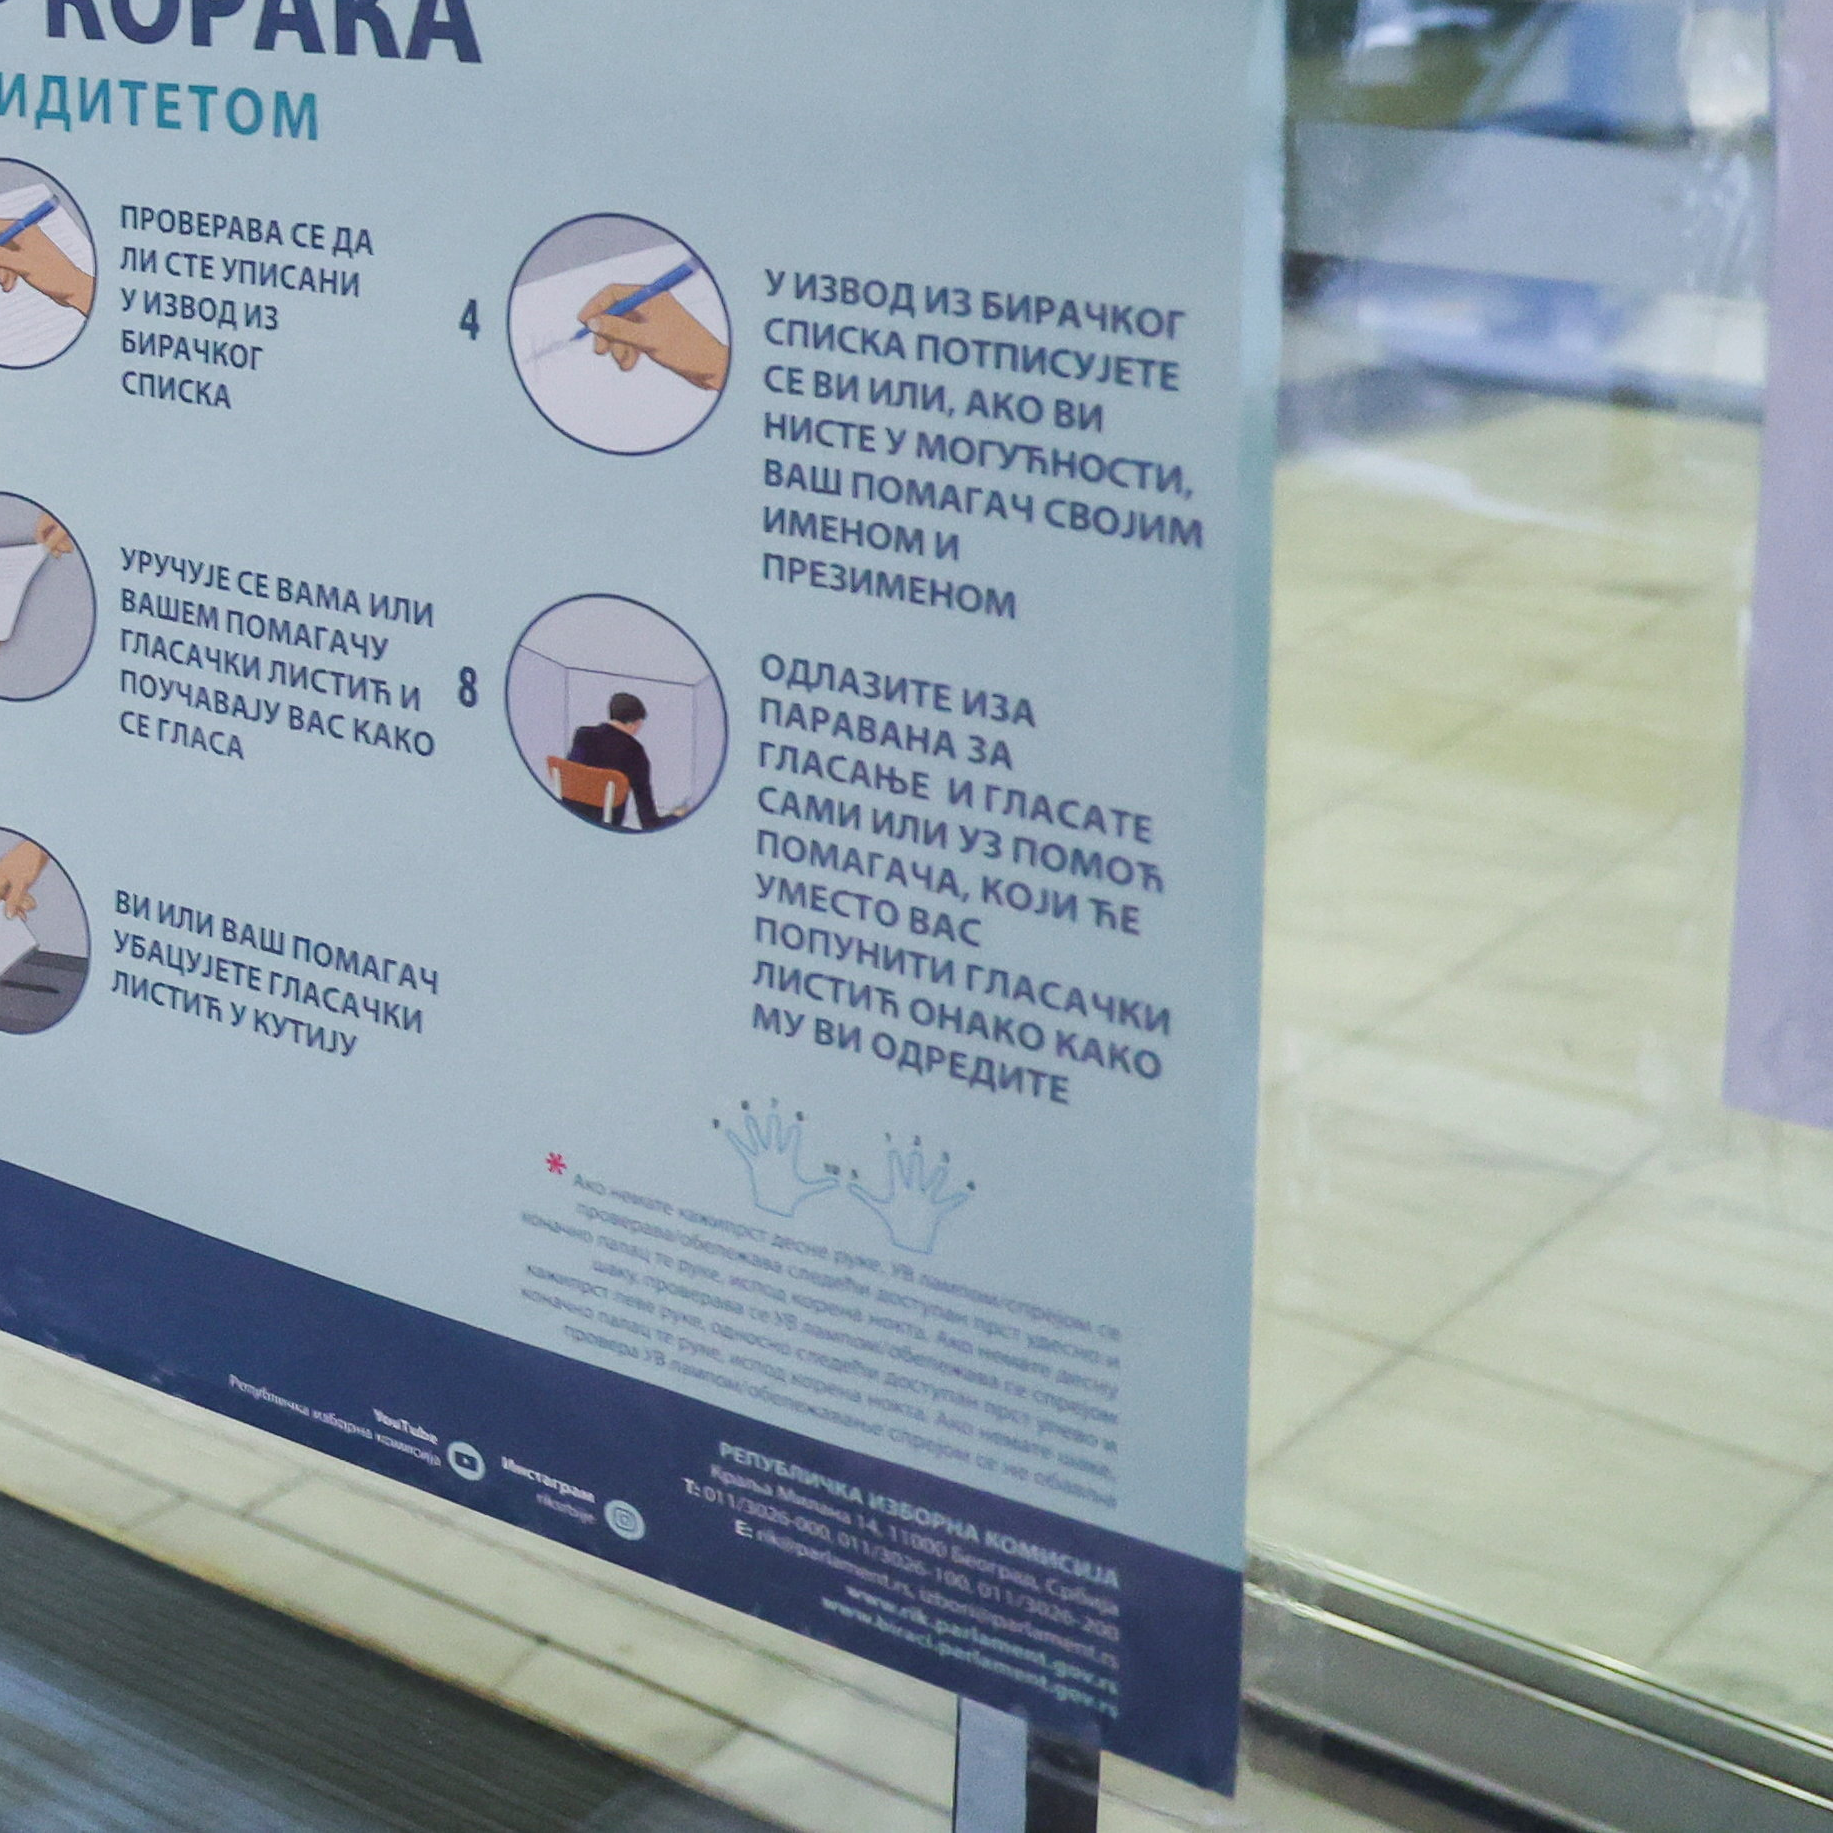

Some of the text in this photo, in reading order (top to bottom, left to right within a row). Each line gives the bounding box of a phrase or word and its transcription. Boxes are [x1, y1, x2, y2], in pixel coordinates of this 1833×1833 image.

[121, 205, 374, 258] ПРОВЕРАВА СЕ ДА
[121, 247, 360, 298] ЛИ СТЕ УПИСАНИ
[121, 288, 278, 331] У ИЗВОД ИЗ
[764, 269, 1185, 340] У ИЗВОД ИЗ БИРАЧКОГ
[122, 330, 262, 371] БИРАЧКОГ
[459, 299, 480, 340] 4
[764, 317, 1179, 394] СПИСКА ПОТПИСУЈЕТЕ
[122, 372, 231, 409] СПИСКА
[764, 365, 1103, 434] СЕ ВИ ИЛИ, АКО ВИ
[764, 412, 1193, 501] НИСТЕ У МОГУЋНОСТИ,
[764, 460, 1203, 549] ВАШ ПОМАГАЧ СВОЈИМ
[764, 507, 959, 562] ИМЕНОМ И
[120, 547, 434, 629] УРУЧУЈЕ СЕ ВАМА ИЛИ
[122, 589, 388, 662] ВАШЕМ ПОМАГАЧУ
[764, 554, 1016, 620] ПРЕЗИМЕНОМ
[120, 629, 420, 711] ГЛАСАЧКИ ЛИСТИЋ И
[459, 667, 477, 709] 8
[760, 653, 1035, 729] ОДЛАЗИТЕ ИЗА
[120, 670, 435, 757] ПОУЧАВАЈУ ВАС КАКО
[120, 711, 244, 760] СЕ ГЛАСА
[760, 698, 1012, 770] ПАРАВАНА ЗА
[759, 742, 1152, 845] ГЛАСАЊЕ И ГЛАСАТЕ
[758, 786, 1165, 894] САМИ ИЛИ УЗ ПОМОЋ
[756, 872, 982, 949] УМЕСТО ВАС
[757, 830, 1141, 937] ПОМАГАЧА, КОЈИ ЋЕ
[117, 890, 438, 995] ВИ ИЛИ ВАШ ПОМАГАЧ
[756, 917, 1171, 1036] ПОПУНИТИ ГЛАСАЧКИ
[112, 970, 357, 1058] ЛИСТИЋ У КУТИЈУ
[114, 930, 423, 1034] УБАЦУЈЕТЕ ГЛАСАЧКИ
[754, 960, 1163, 1080] ЛИСТИЋ ОНАКО КАКО
[753, 1005, 1069, 1106] МУ ВИ ОДРЕДИТЕ
[720, 1442, 1119, 1588] РЕПУБЛИЧКА ИЗБОРНА КОМИСИЈА
